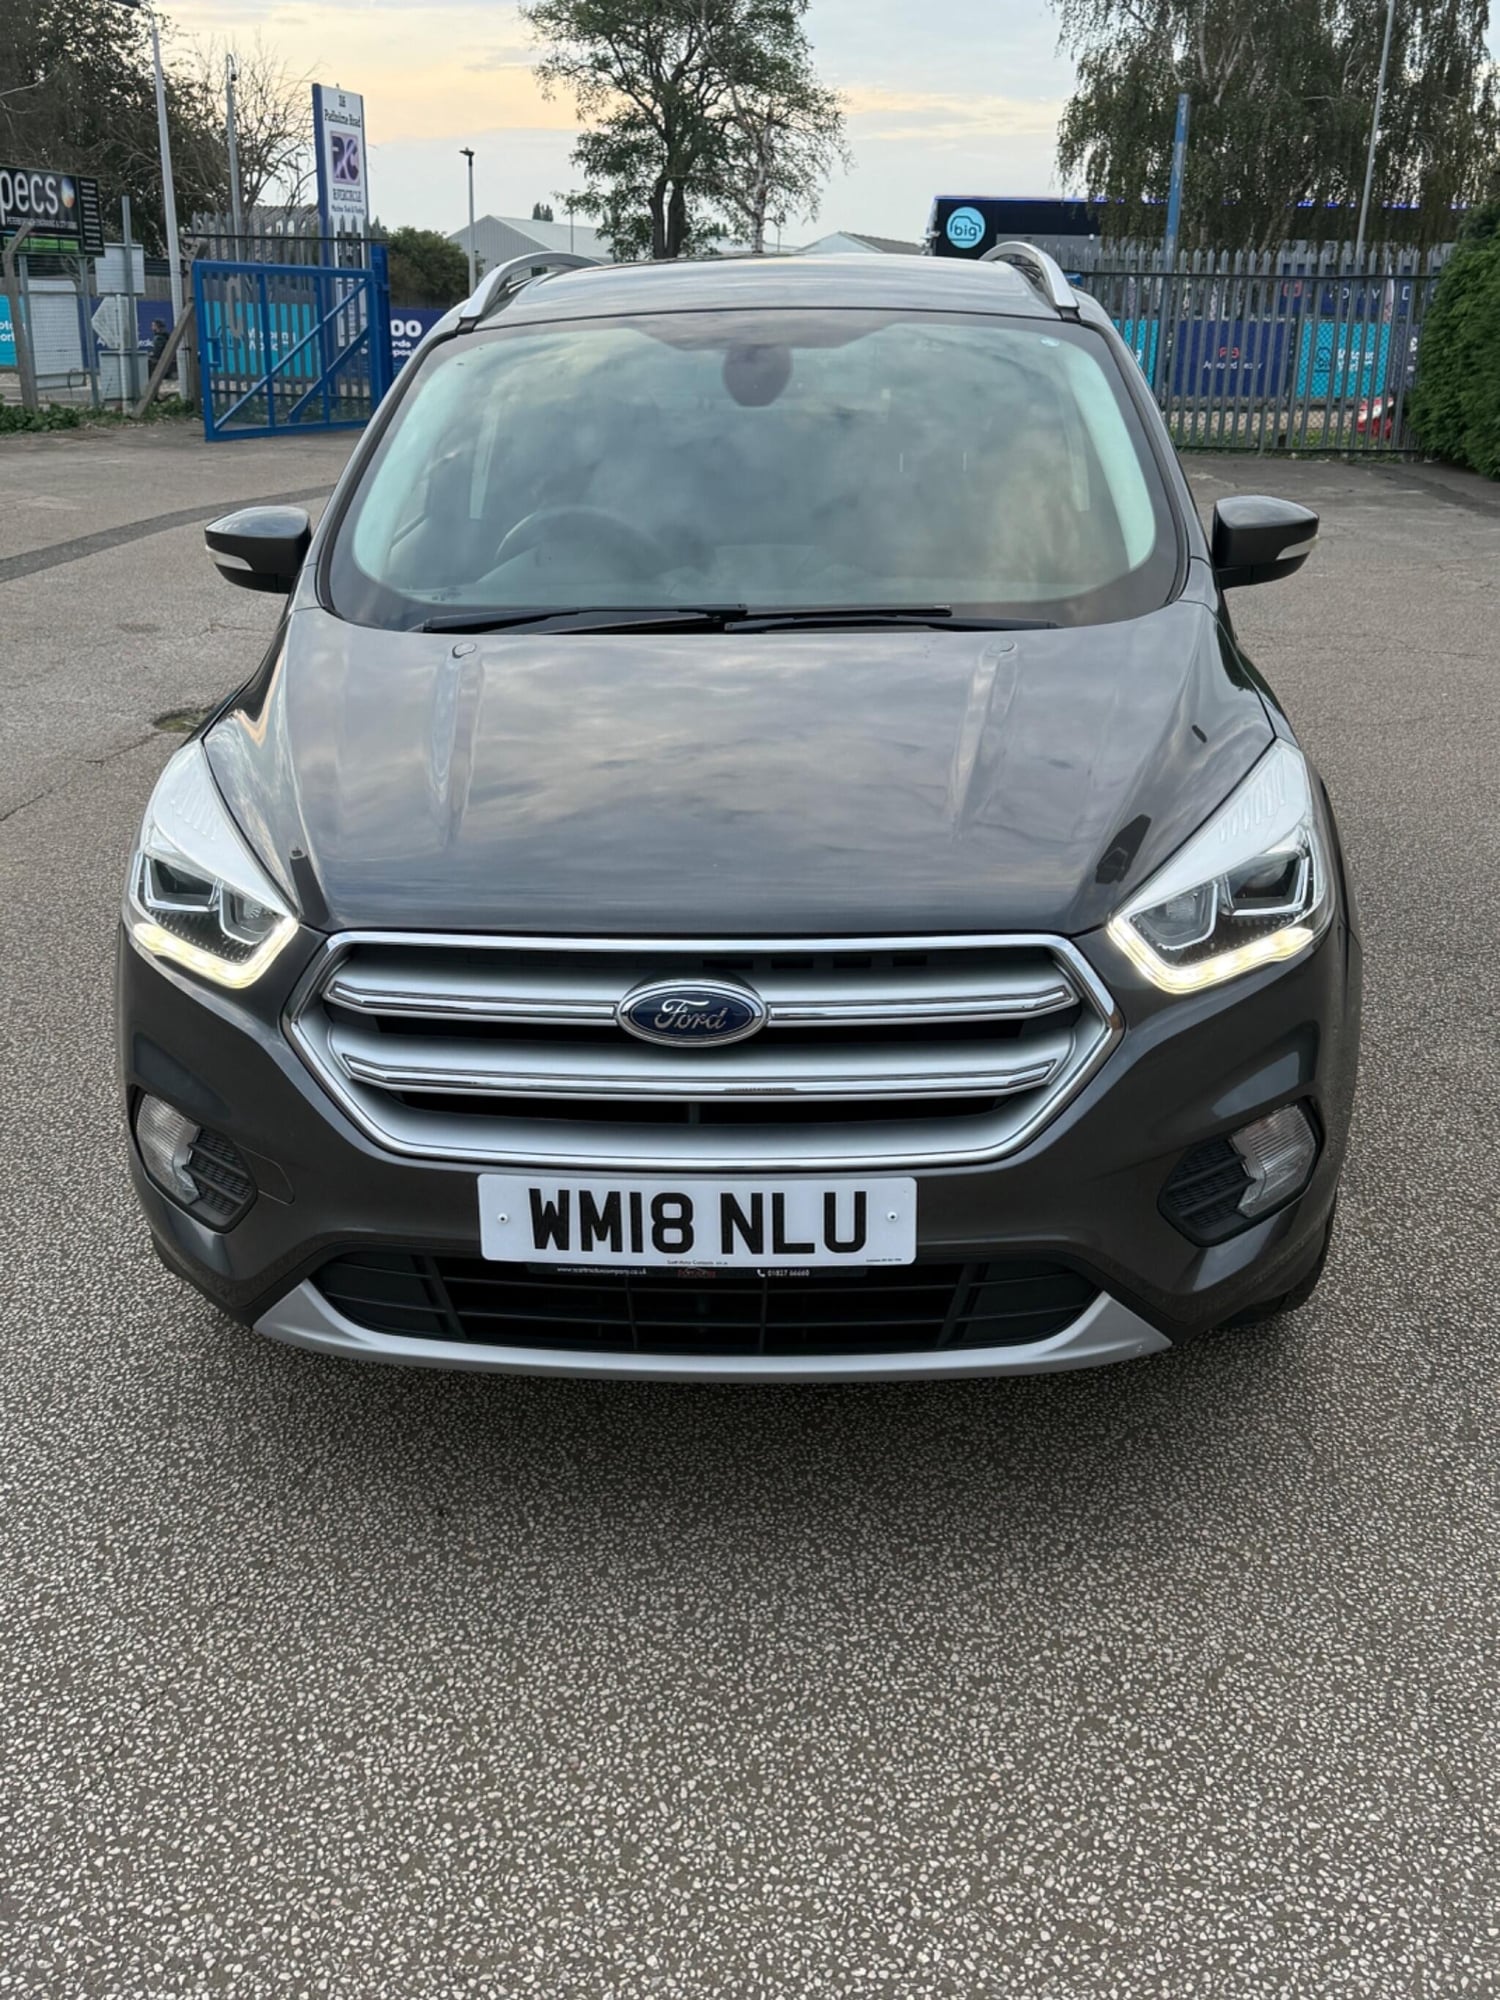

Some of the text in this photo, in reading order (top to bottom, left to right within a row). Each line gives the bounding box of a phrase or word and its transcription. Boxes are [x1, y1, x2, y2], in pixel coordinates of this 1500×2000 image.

[0, 170, 59, 226] pecs
[954, 224, 977, 240] big
[654, 999, 729, 1030] Ford
[528, 1188, 867, 1255] WM18 NLU
